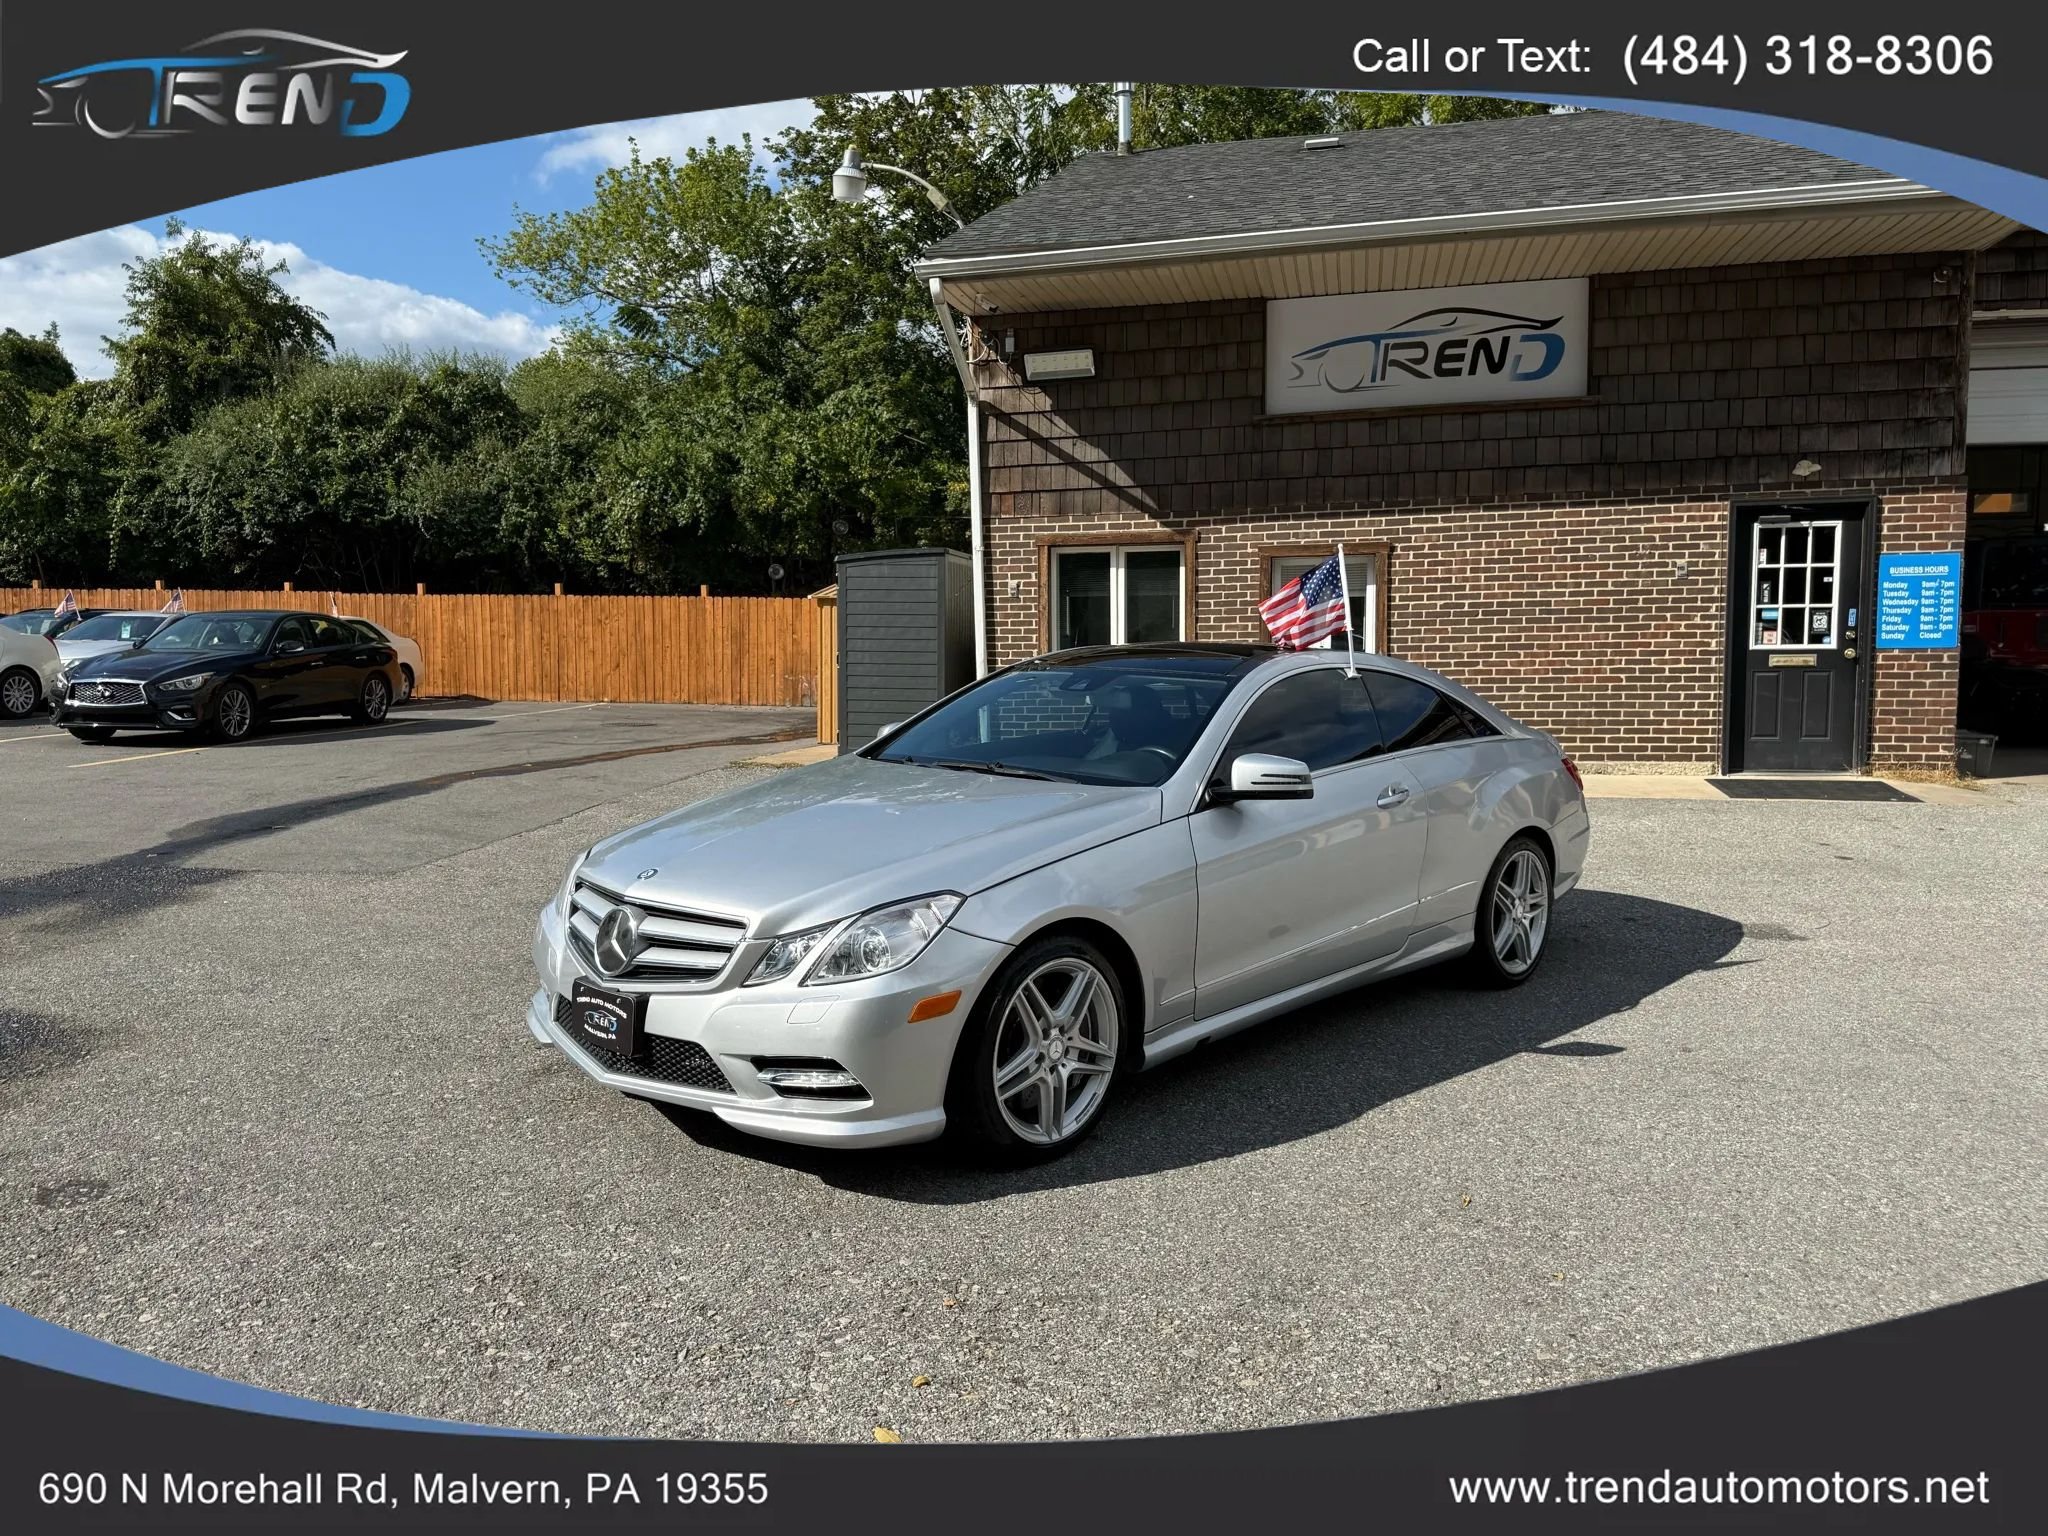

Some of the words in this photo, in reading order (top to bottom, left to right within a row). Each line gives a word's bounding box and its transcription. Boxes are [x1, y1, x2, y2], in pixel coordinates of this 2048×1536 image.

[1355, 330, 1566, 384] TREND
[1890, 566, 1923, 574] BUSINESS
[1925, 565, 1949, 573] HOURS
[1883, 581, 1908, 589] Monday
[1882, 607, 1912, 615] Thursday
